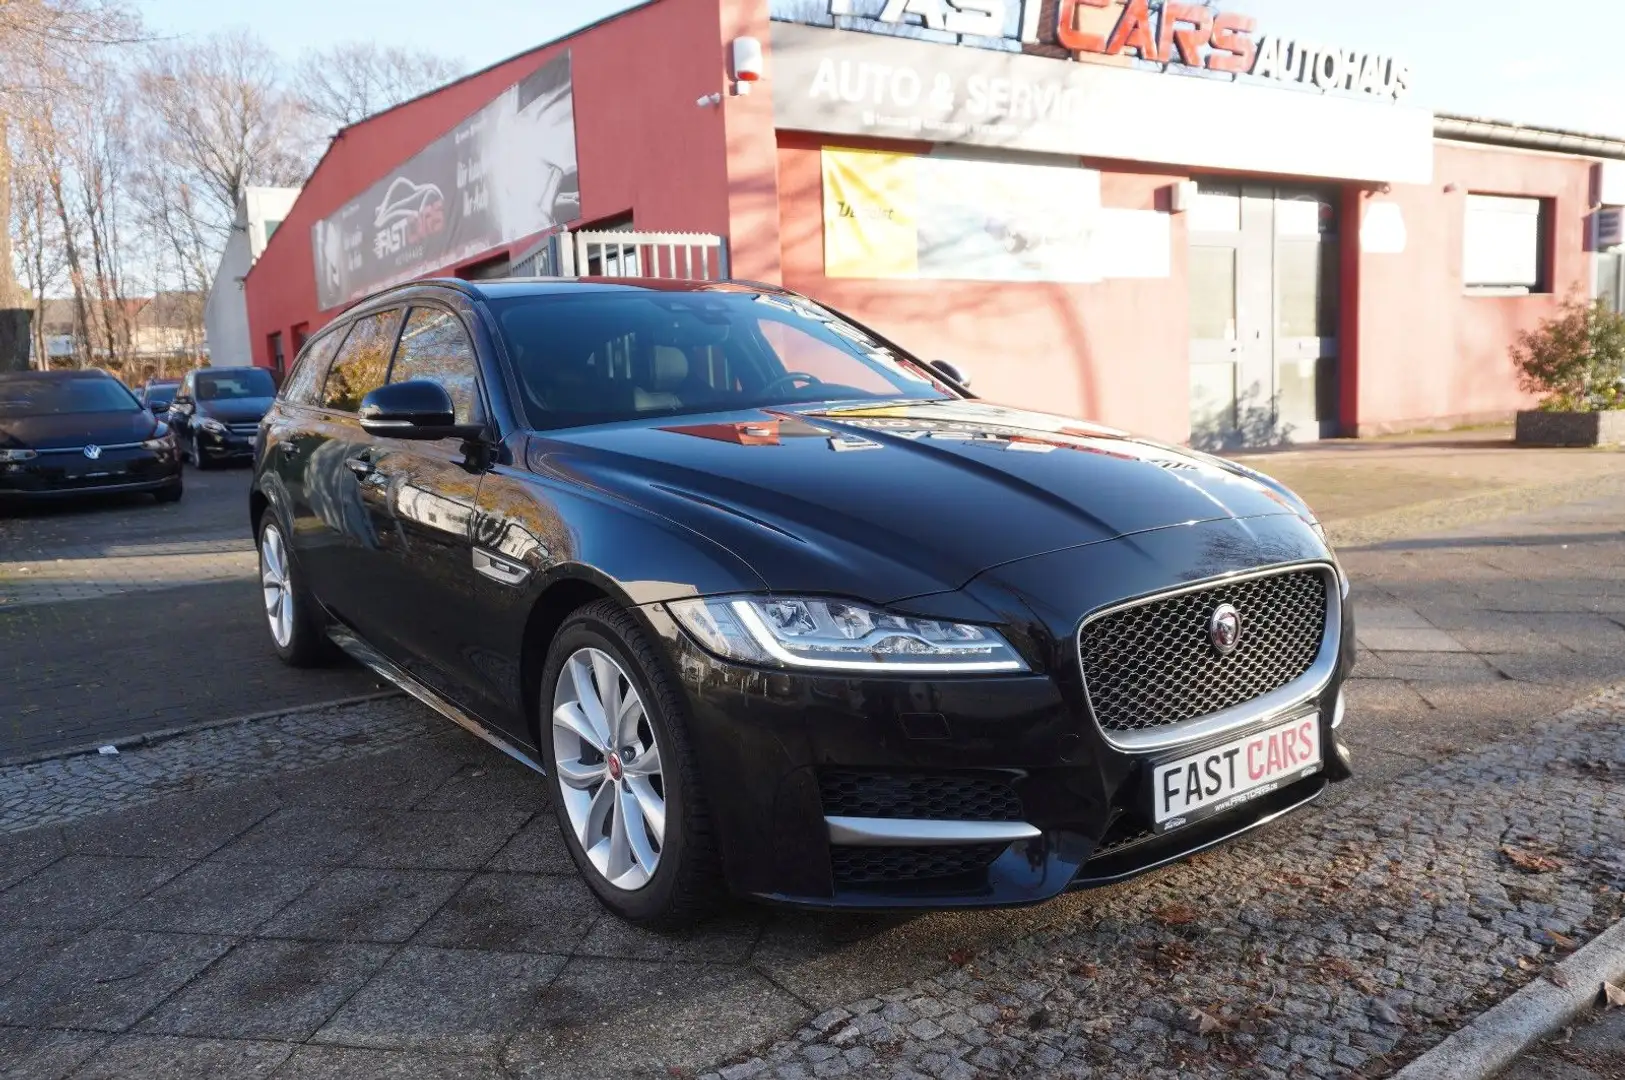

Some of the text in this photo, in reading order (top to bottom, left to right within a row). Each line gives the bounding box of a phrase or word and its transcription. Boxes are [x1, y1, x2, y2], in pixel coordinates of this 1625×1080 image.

[1057, 0, 1257, 73] CARS
[1253, 35, 1410, 100] AUTOHAUS
[808, 57, 922, 108] AUTO
[929, 71, 955, 112] &
[1162, 721, 1314, 813] FAST CARS
